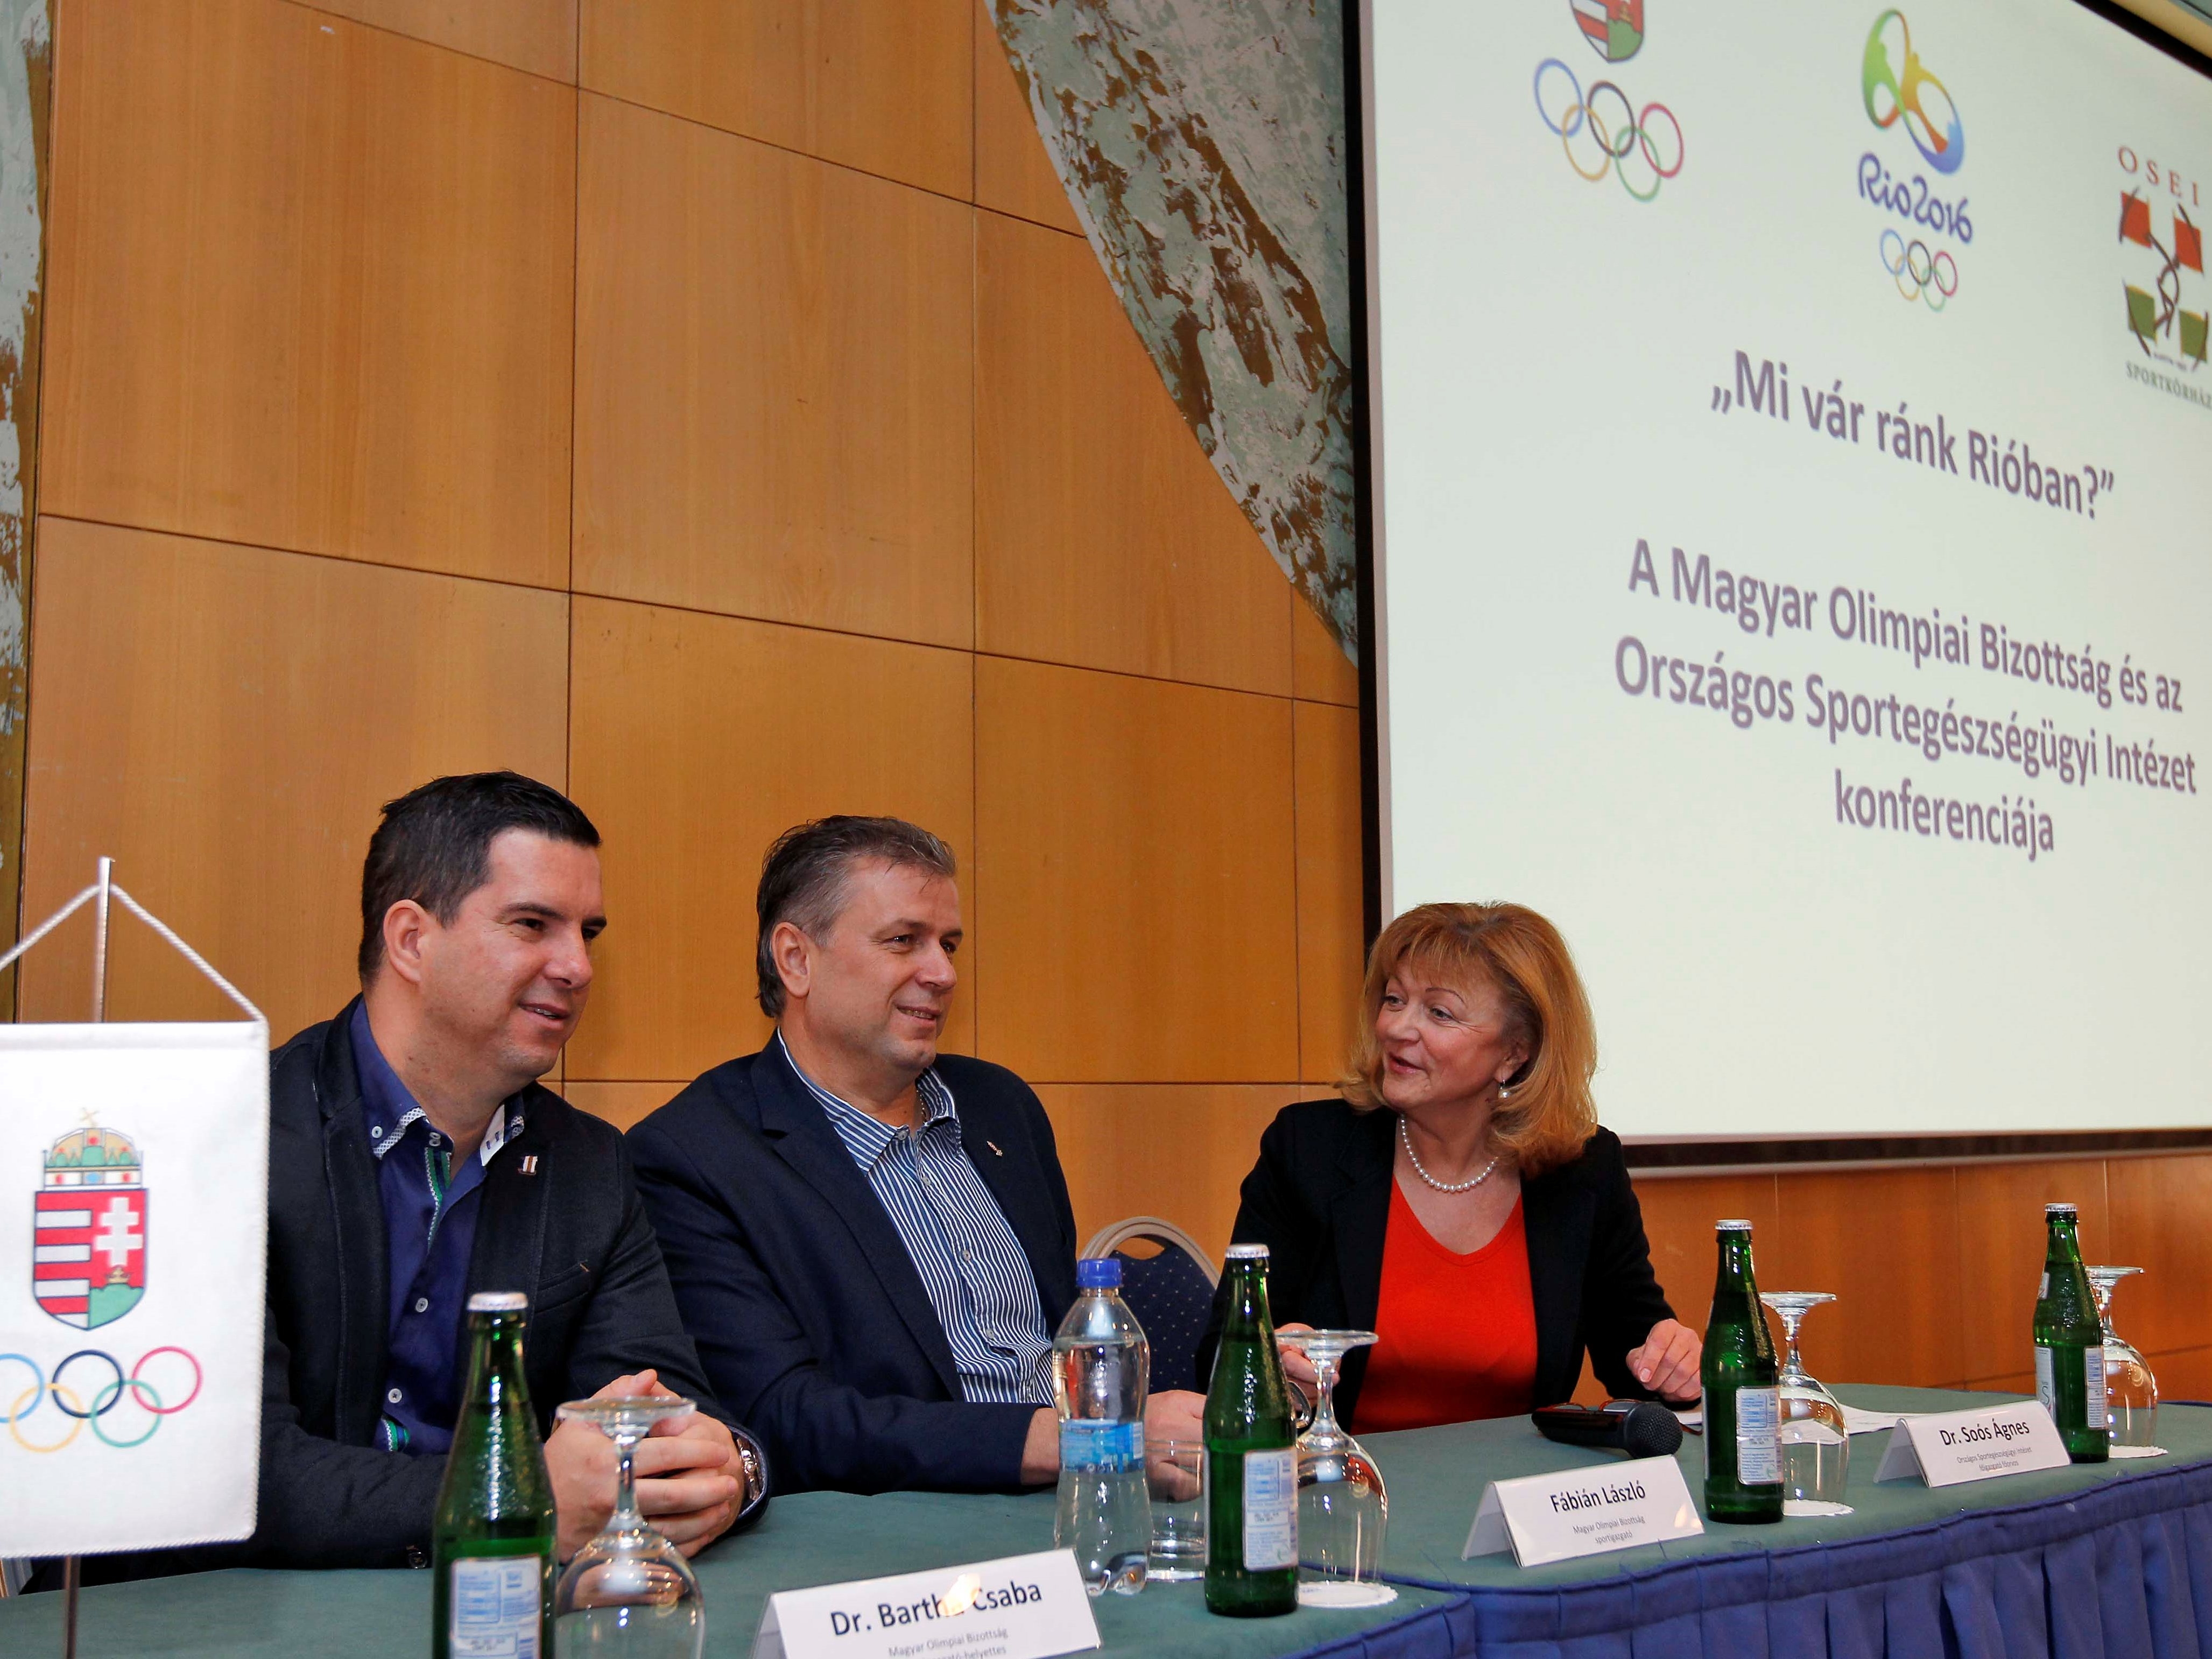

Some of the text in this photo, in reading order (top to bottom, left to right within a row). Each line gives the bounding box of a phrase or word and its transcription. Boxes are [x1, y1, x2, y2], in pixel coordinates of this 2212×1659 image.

[2118, 145, 2200, 208] OSEI
[1801, 379, 1864, 444] vár
[1876, 402, 1958, 476] ránk
[1968, 429, 2114, 519] Rióban?”
[1628, 538, 2183, 713] A Magyar Olimpiai Bizottság és az
[1615, 636, 2197, 795] Országos Sportegészségügyi Intézet
[1835, 769, 2054, 861] konferenciája
[1939, 1418, 2030, 1446] Dr. Soós Ágnes
[1550, 1480, 1646, 1513] Fábián László
[1572, 1515, 1646, 1535] Magyar Olimpiai Bizottság
[830, 1580, 1042, 1636] Dr. Barth Csaba
[888, 1628, 1009, 1657] Magyar Olimpiai Bizottság
